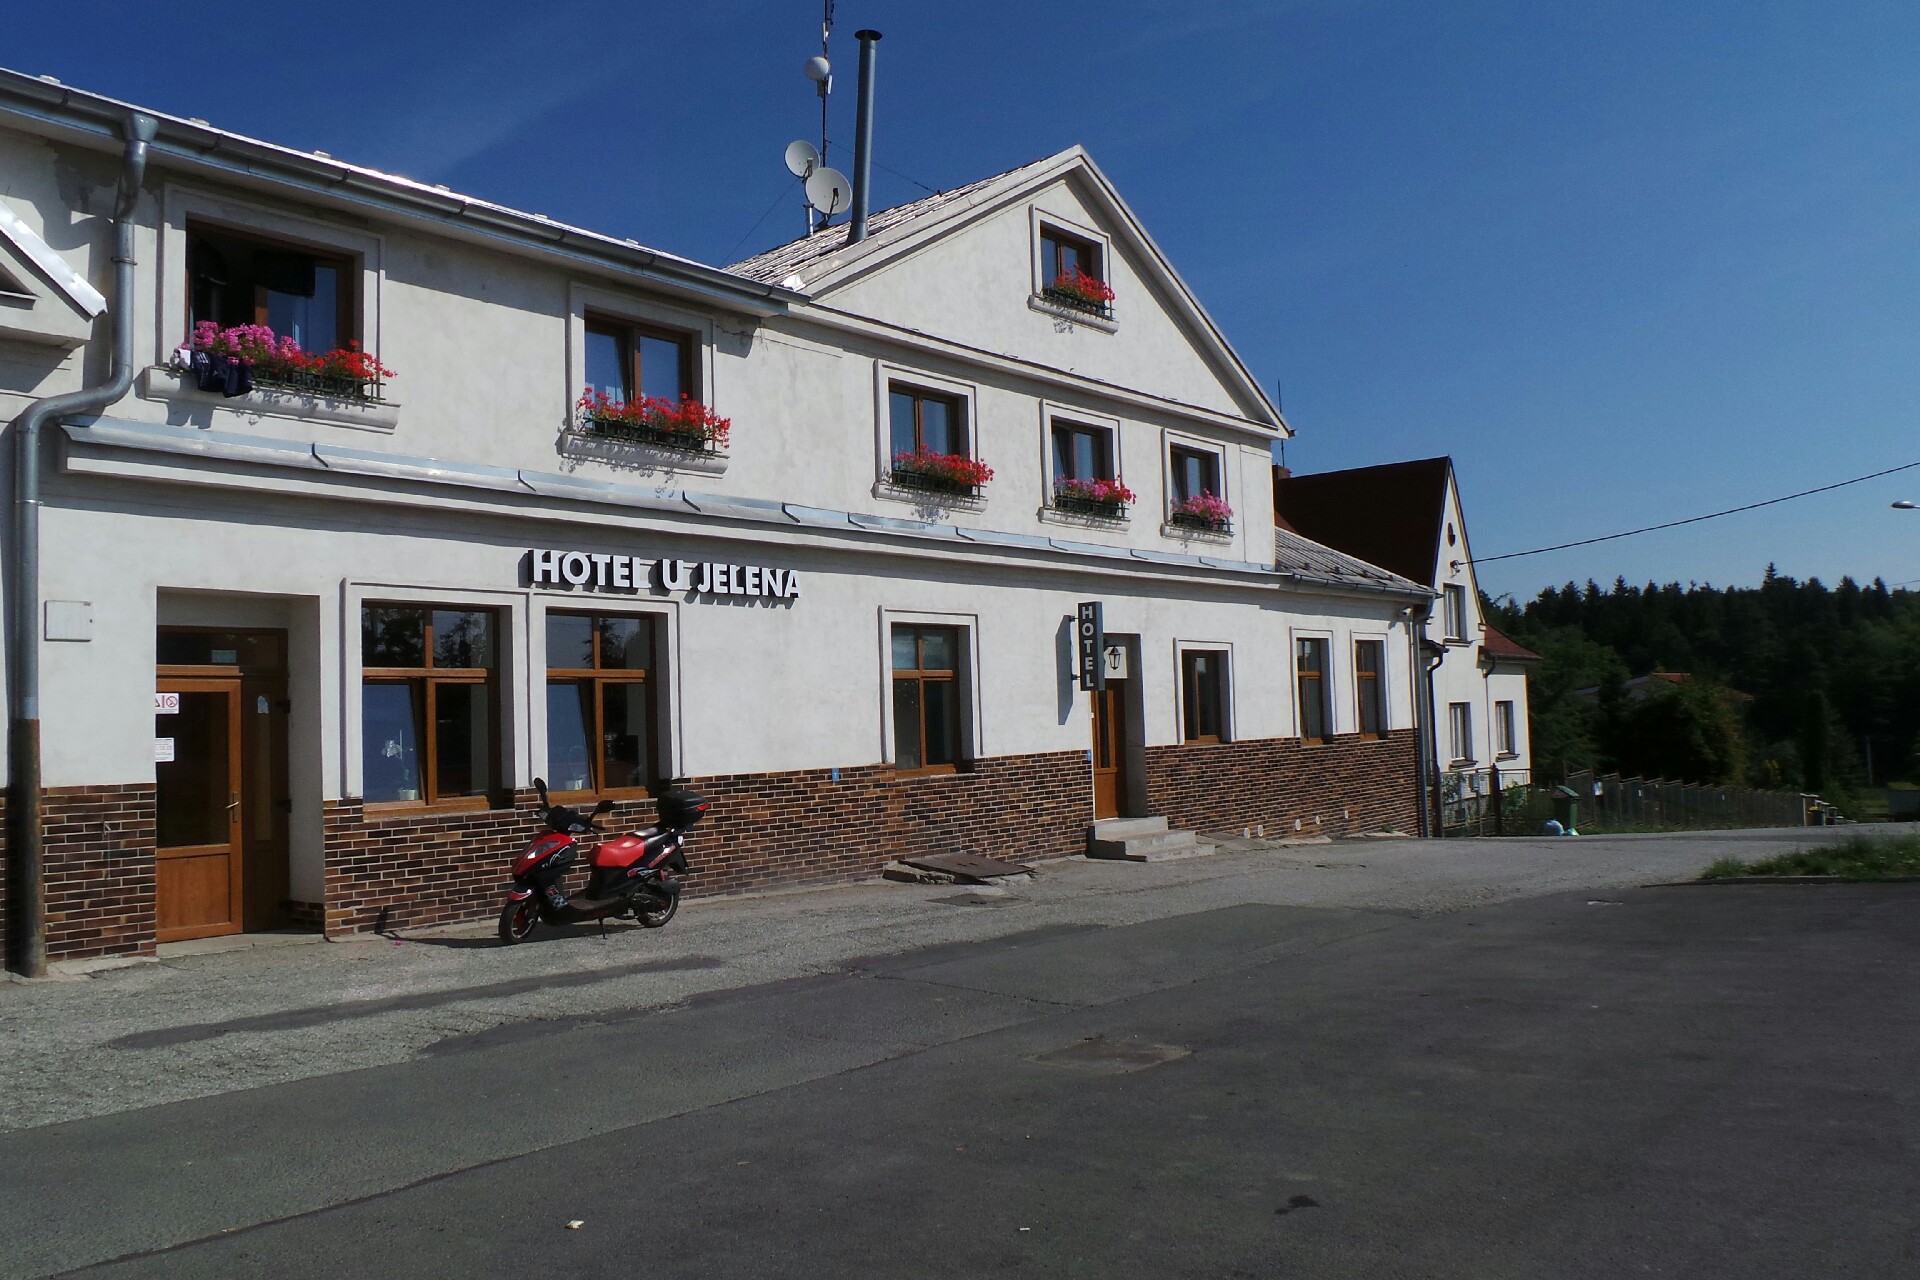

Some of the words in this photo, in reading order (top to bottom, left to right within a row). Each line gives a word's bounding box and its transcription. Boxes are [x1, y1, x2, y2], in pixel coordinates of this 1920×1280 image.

[532, 549, 651, 589] HOTEL
[661, 558, 685, 591] U
[697, 561, 801, 599] JELENA
[1081, 605, 1094, 688] HOTEL
